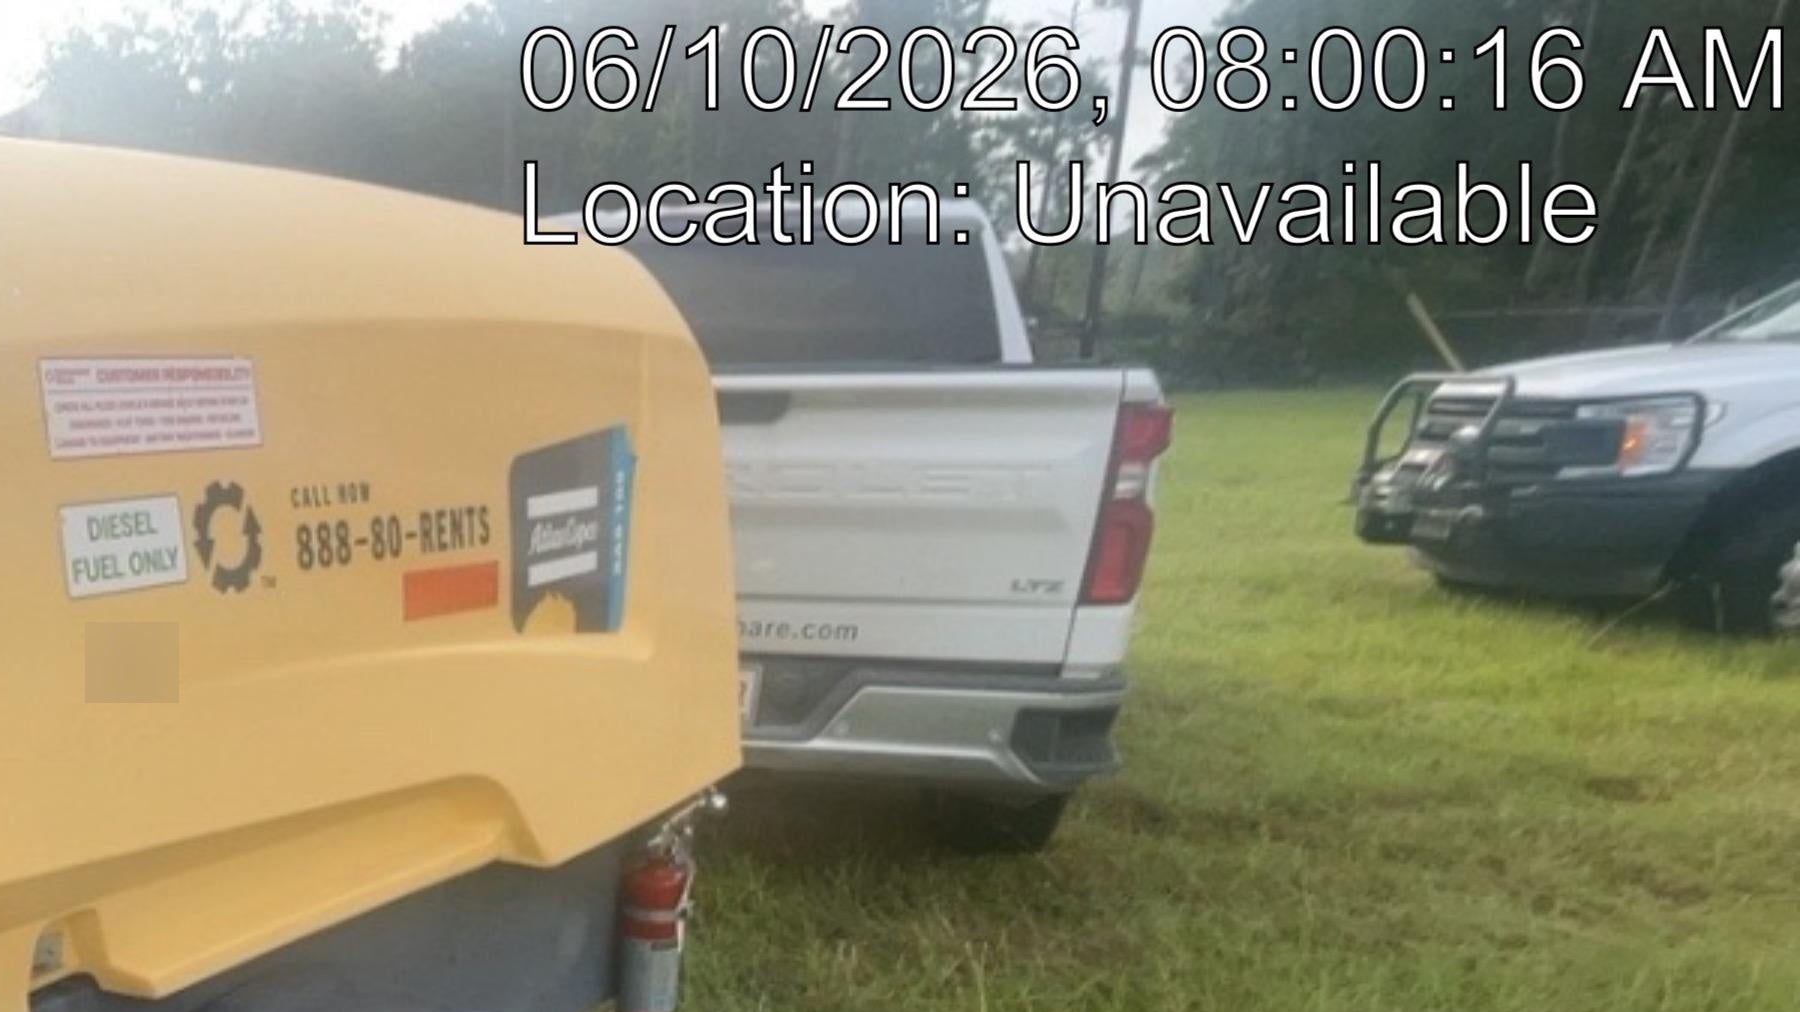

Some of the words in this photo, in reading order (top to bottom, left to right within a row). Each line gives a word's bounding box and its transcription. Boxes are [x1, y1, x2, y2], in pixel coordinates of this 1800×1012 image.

[290, 485, 332, 509] CALL
[337, 481, 370, 504] NOW
[85, 511, 159, 543] DIESEL
[296, 504, 491, 571] 888-80-RENTS
[71, 553, 125, 585] FUEL
[128, 546, 180, 577] ONLY
